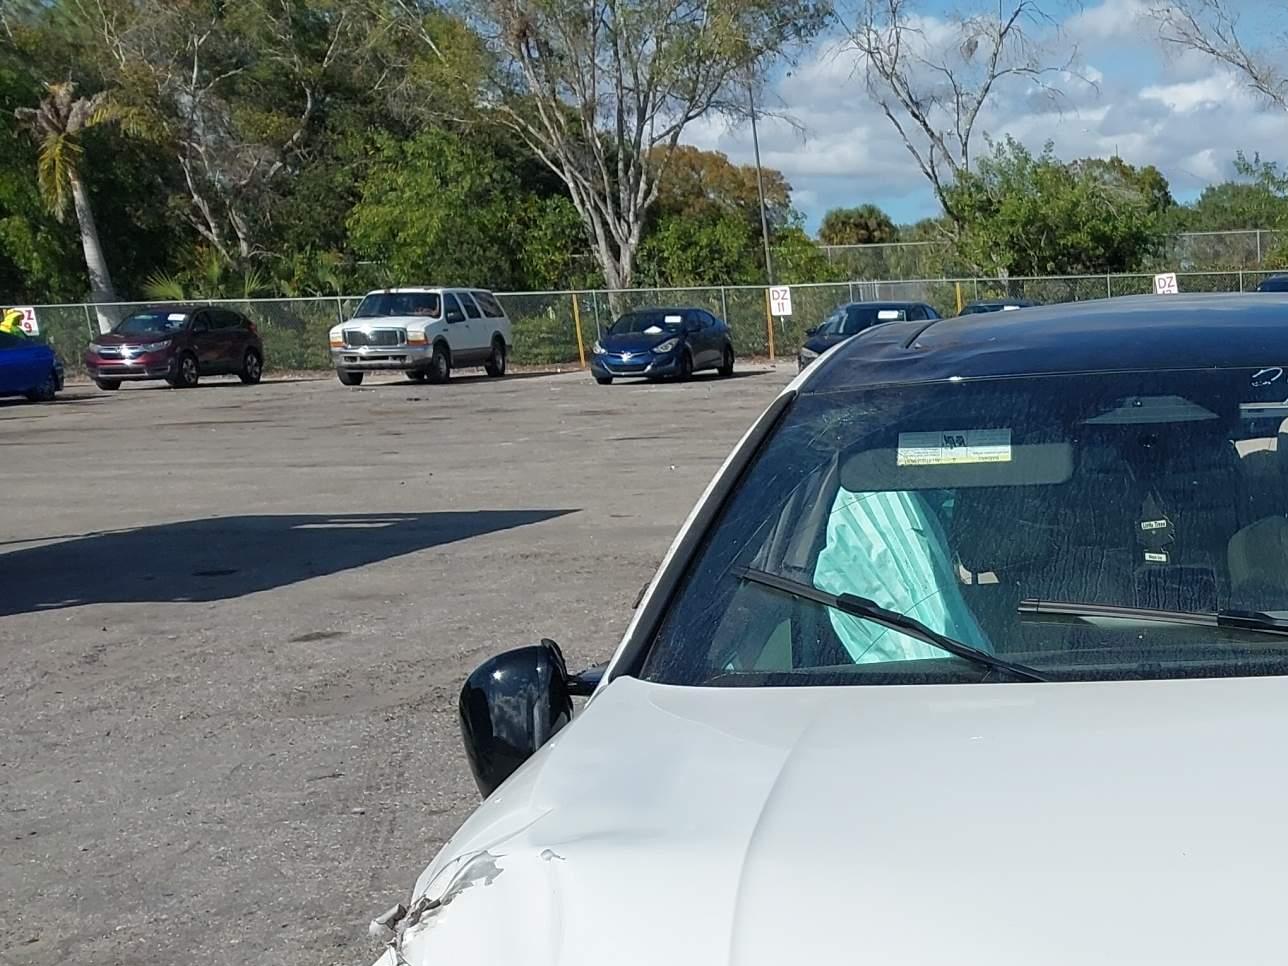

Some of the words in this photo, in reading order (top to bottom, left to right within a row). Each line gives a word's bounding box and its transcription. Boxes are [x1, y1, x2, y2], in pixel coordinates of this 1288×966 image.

[1158, 276, 1175, 289] DZ
[772, 289, 789, 301] DZ
[777, 302, 785, 313] 11
[23, 321, 33, 333] 9
